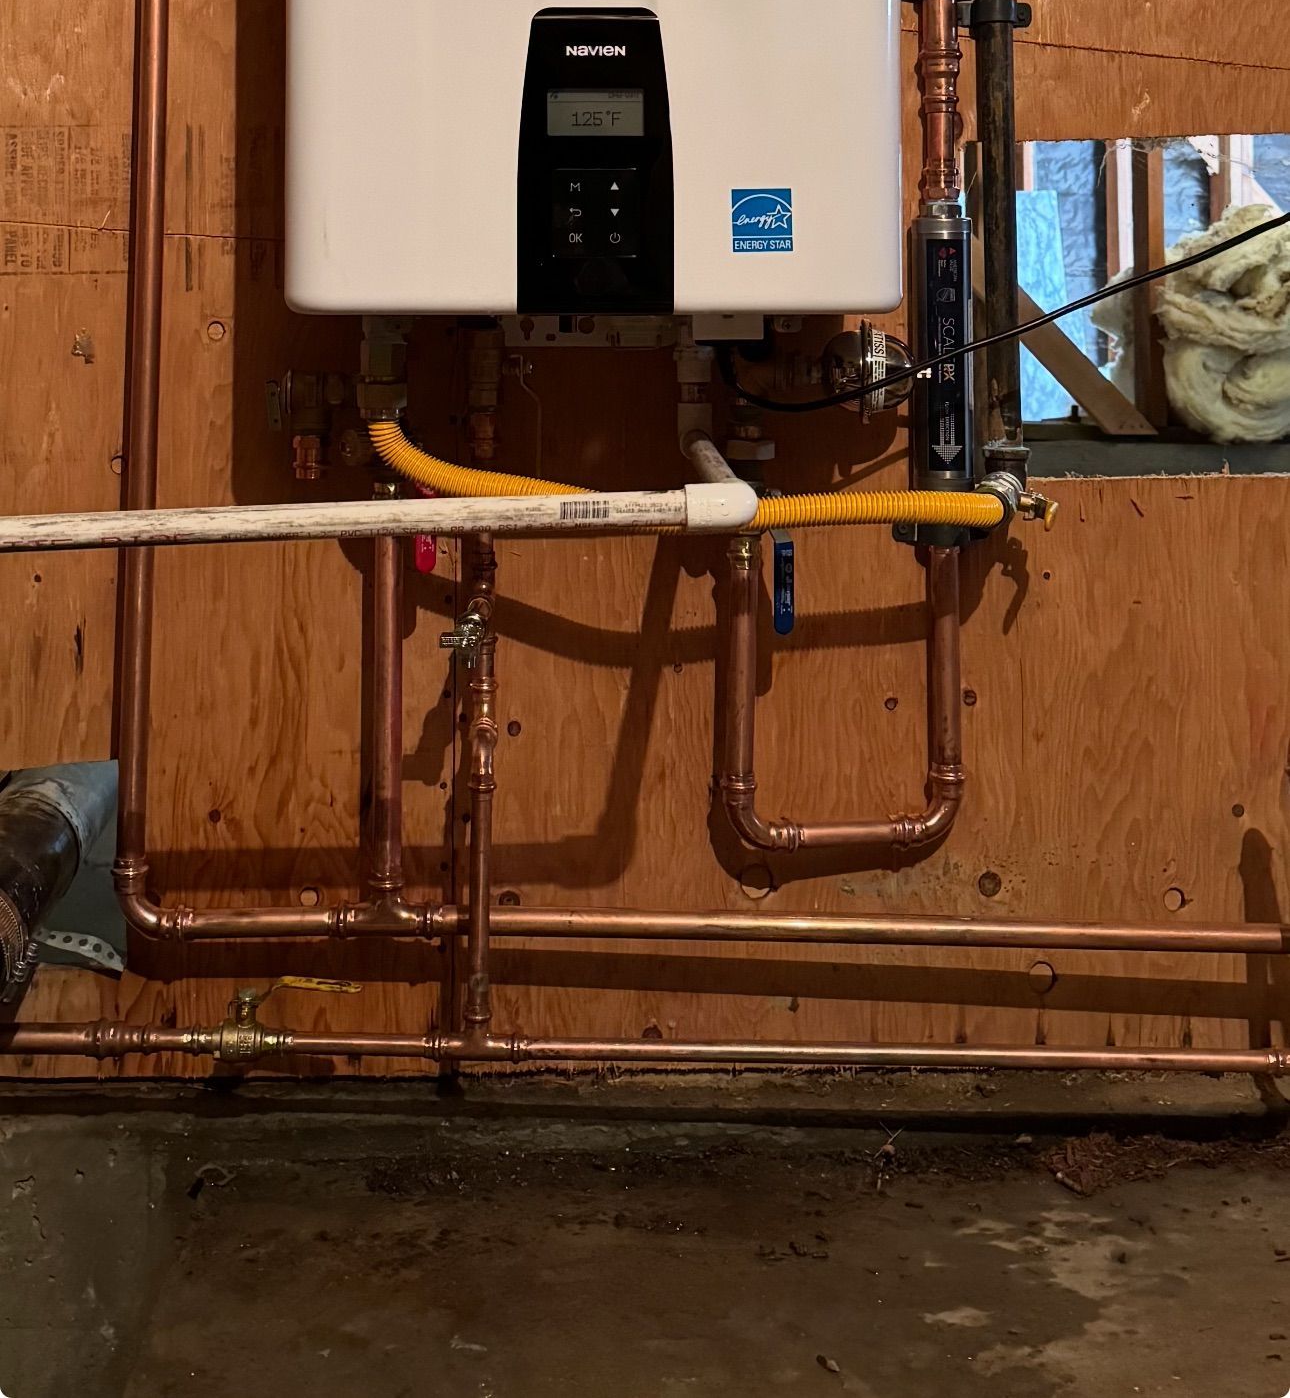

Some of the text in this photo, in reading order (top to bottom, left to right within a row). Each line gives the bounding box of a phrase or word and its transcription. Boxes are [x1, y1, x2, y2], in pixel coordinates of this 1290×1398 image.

[565, 45, 626, 57] NAVIEN
[571, 110, 622, 128] 125°F
[569, 182, 581, 192] M
[736, 214, 773, 230] energy
[568, 233, 583, 244] OK
[735, 240, 791, 251] ENERGY STAR
[942, 317, 956, 382] SCALRX
[340, 529, 361, 537] PVC
[498, 523, 518, 532] PSI
